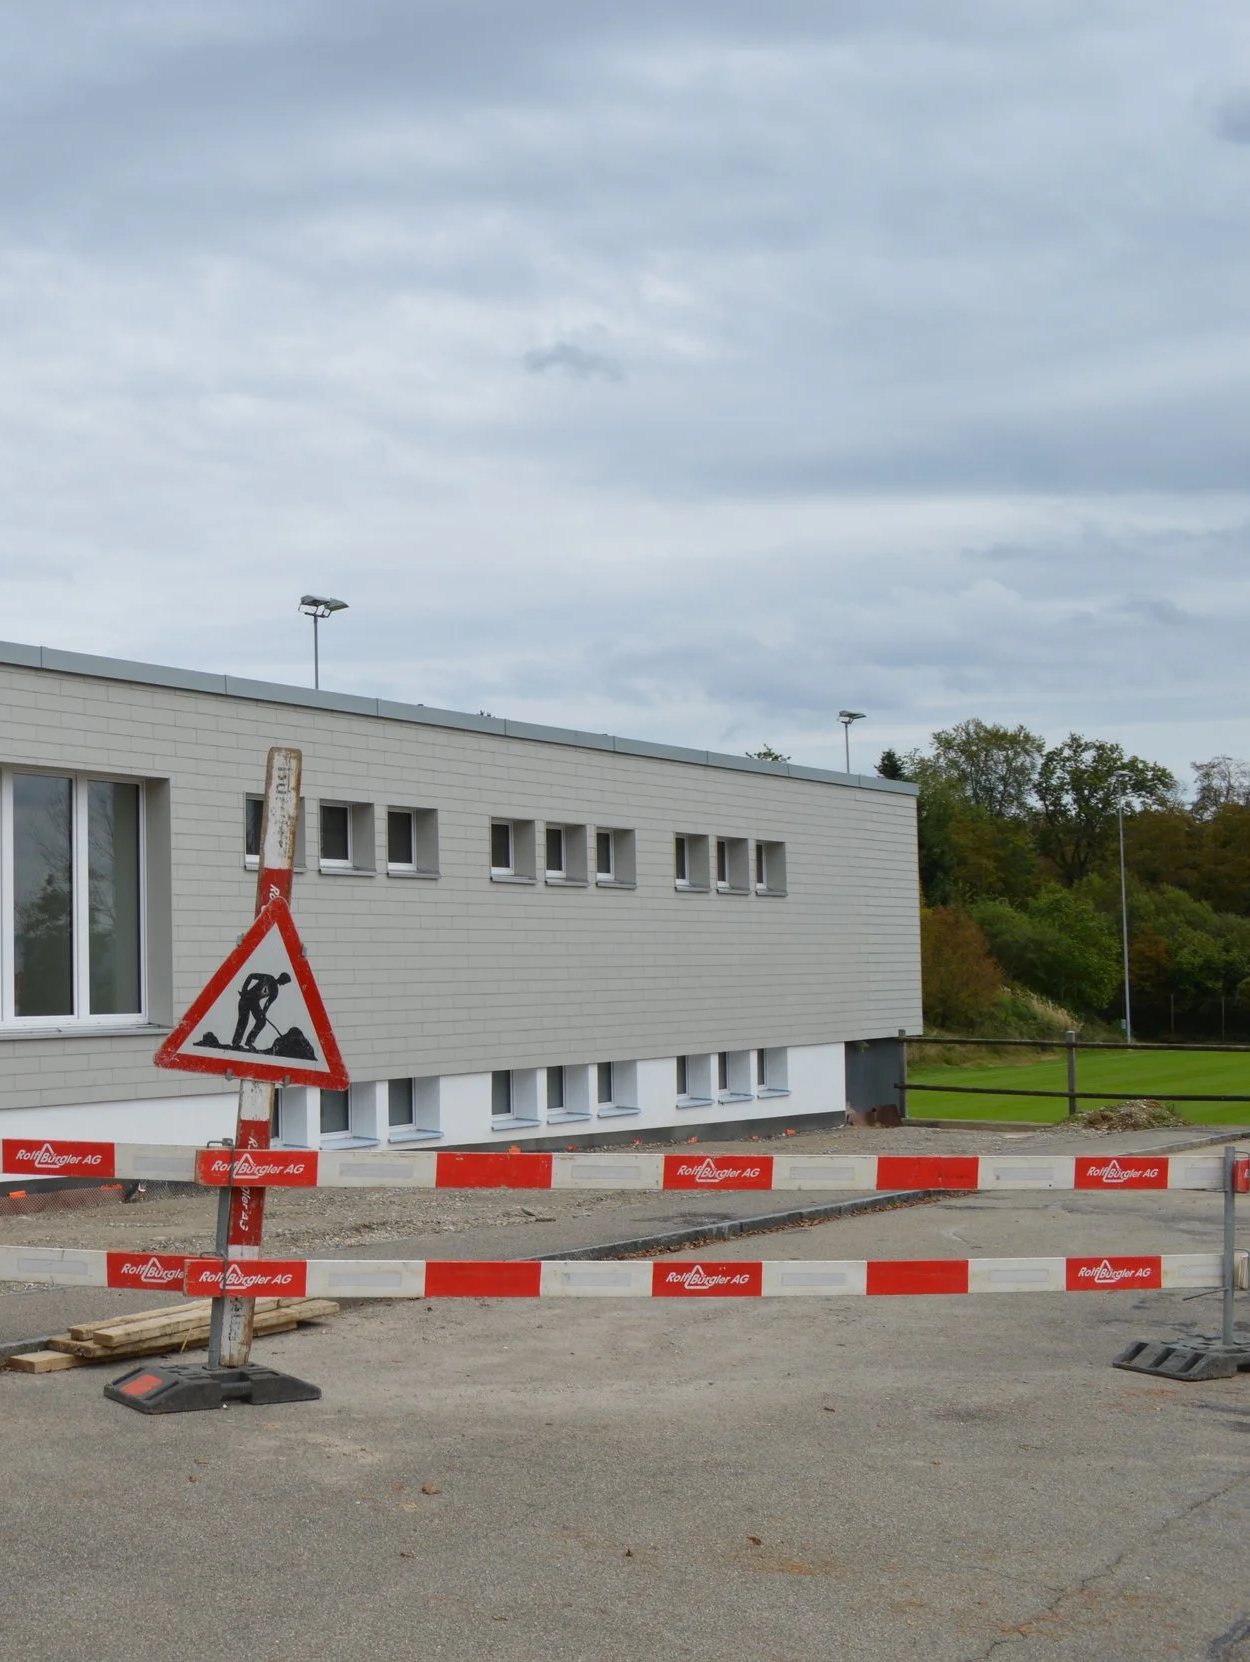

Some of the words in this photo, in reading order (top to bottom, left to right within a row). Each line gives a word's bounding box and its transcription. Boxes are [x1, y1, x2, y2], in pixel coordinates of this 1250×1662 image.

[15, 1149, 42, 1160] Rolf
[40, 1152, 82, 1166] Bürgler
[81, 1155, 102, 1165] AG
[238, 1162, 284, 1177] Bürgler
[283, 1164, 305, 1174] AG
[676, 1165, 703, 1176] Rolf
[701, 1167, 741, 1180] Bürgler
[741, 1168, 761, 1178] AG
[1086, 1166, 1110, 1177] Rolf
[1107, 1168, 1143, 1181] Bürgler
[1142, 1168, 1159, 1178] AG
[121, 1263, 148, 1276] Rolf
[147, 1266, 184, 1281] Bürgle
[198, 1271, 225, 1283] Rolf
[225, 1273, 272, 1288] Bürgler
[271, 1274, 293, 1284] AG
[665, 1272, 692, 1283] Rolf
[689, 1273, 731, 1287] Bürgler
[730, 1274, 750, 1284] AG
[1078, 1266, 1101, 1277] Rolf
[1098, 1268, 1135, 1281] Bürgler
[1134, 1267, 1151, 1277] AG
